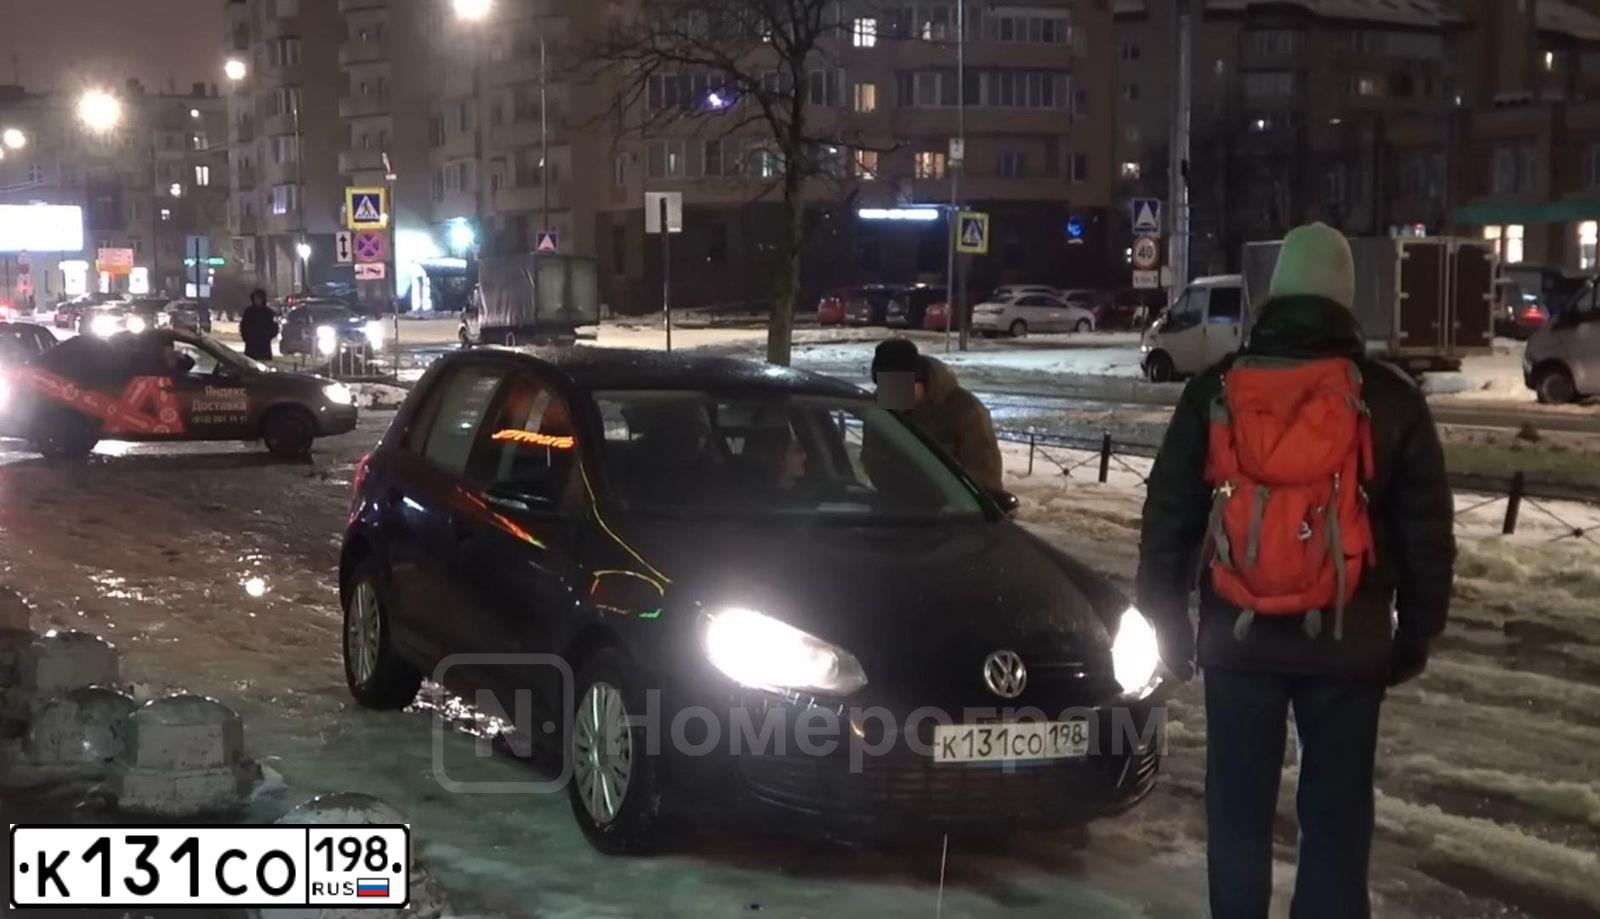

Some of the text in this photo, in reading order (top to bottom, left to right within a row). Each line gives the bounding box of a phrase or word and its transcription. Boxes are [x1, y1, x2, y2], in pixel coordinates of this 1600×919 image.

[1138, 245, 1154, 259] 40
[204, 385, 247, 398] Яндекс
[191, 400, 247, 412] Доставка
[1049, 723, 1084, 747] 198
